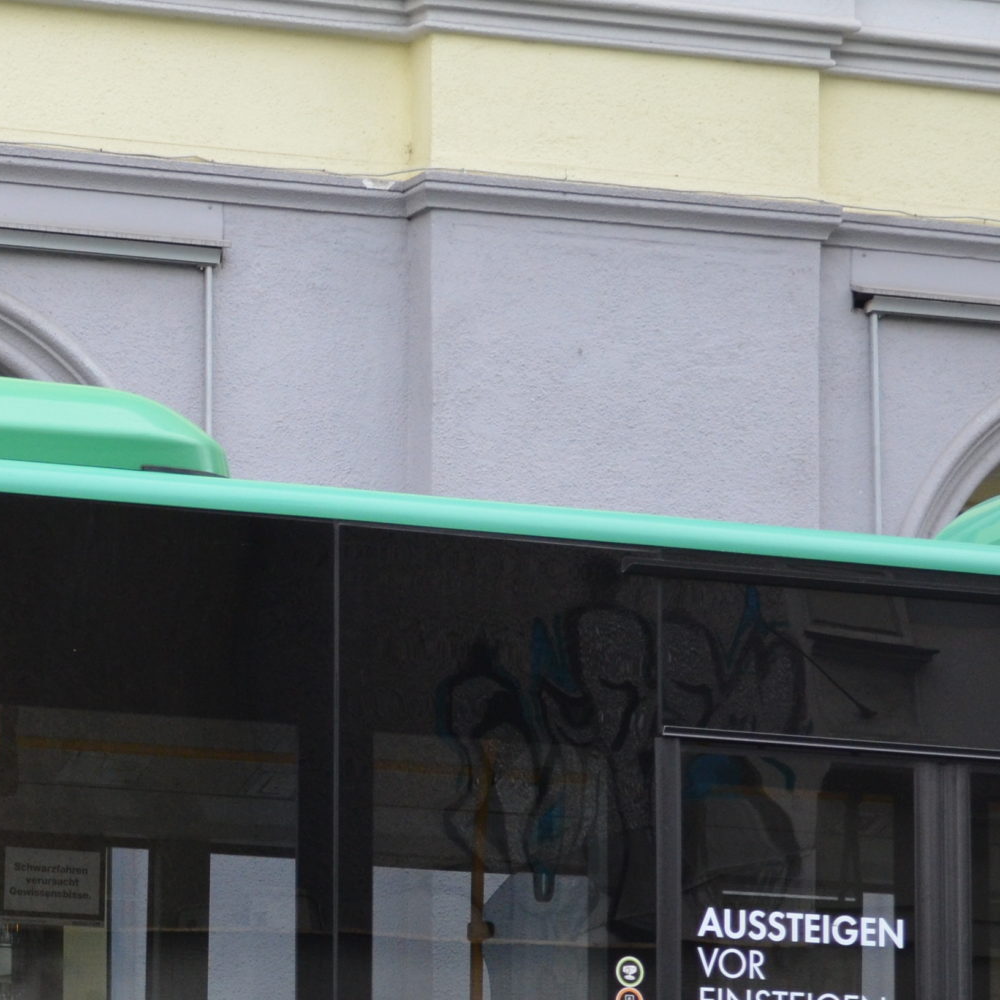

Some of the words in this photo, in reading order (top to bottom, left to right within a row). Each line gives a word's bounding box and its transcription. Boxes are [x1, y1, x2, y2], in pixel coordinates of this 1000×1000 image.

[13, 861, 89, 876] Schwarzfahren
[697, 906, 905, 949] AUSSTEIGEN
[696, 946, 766, 981] VOR
